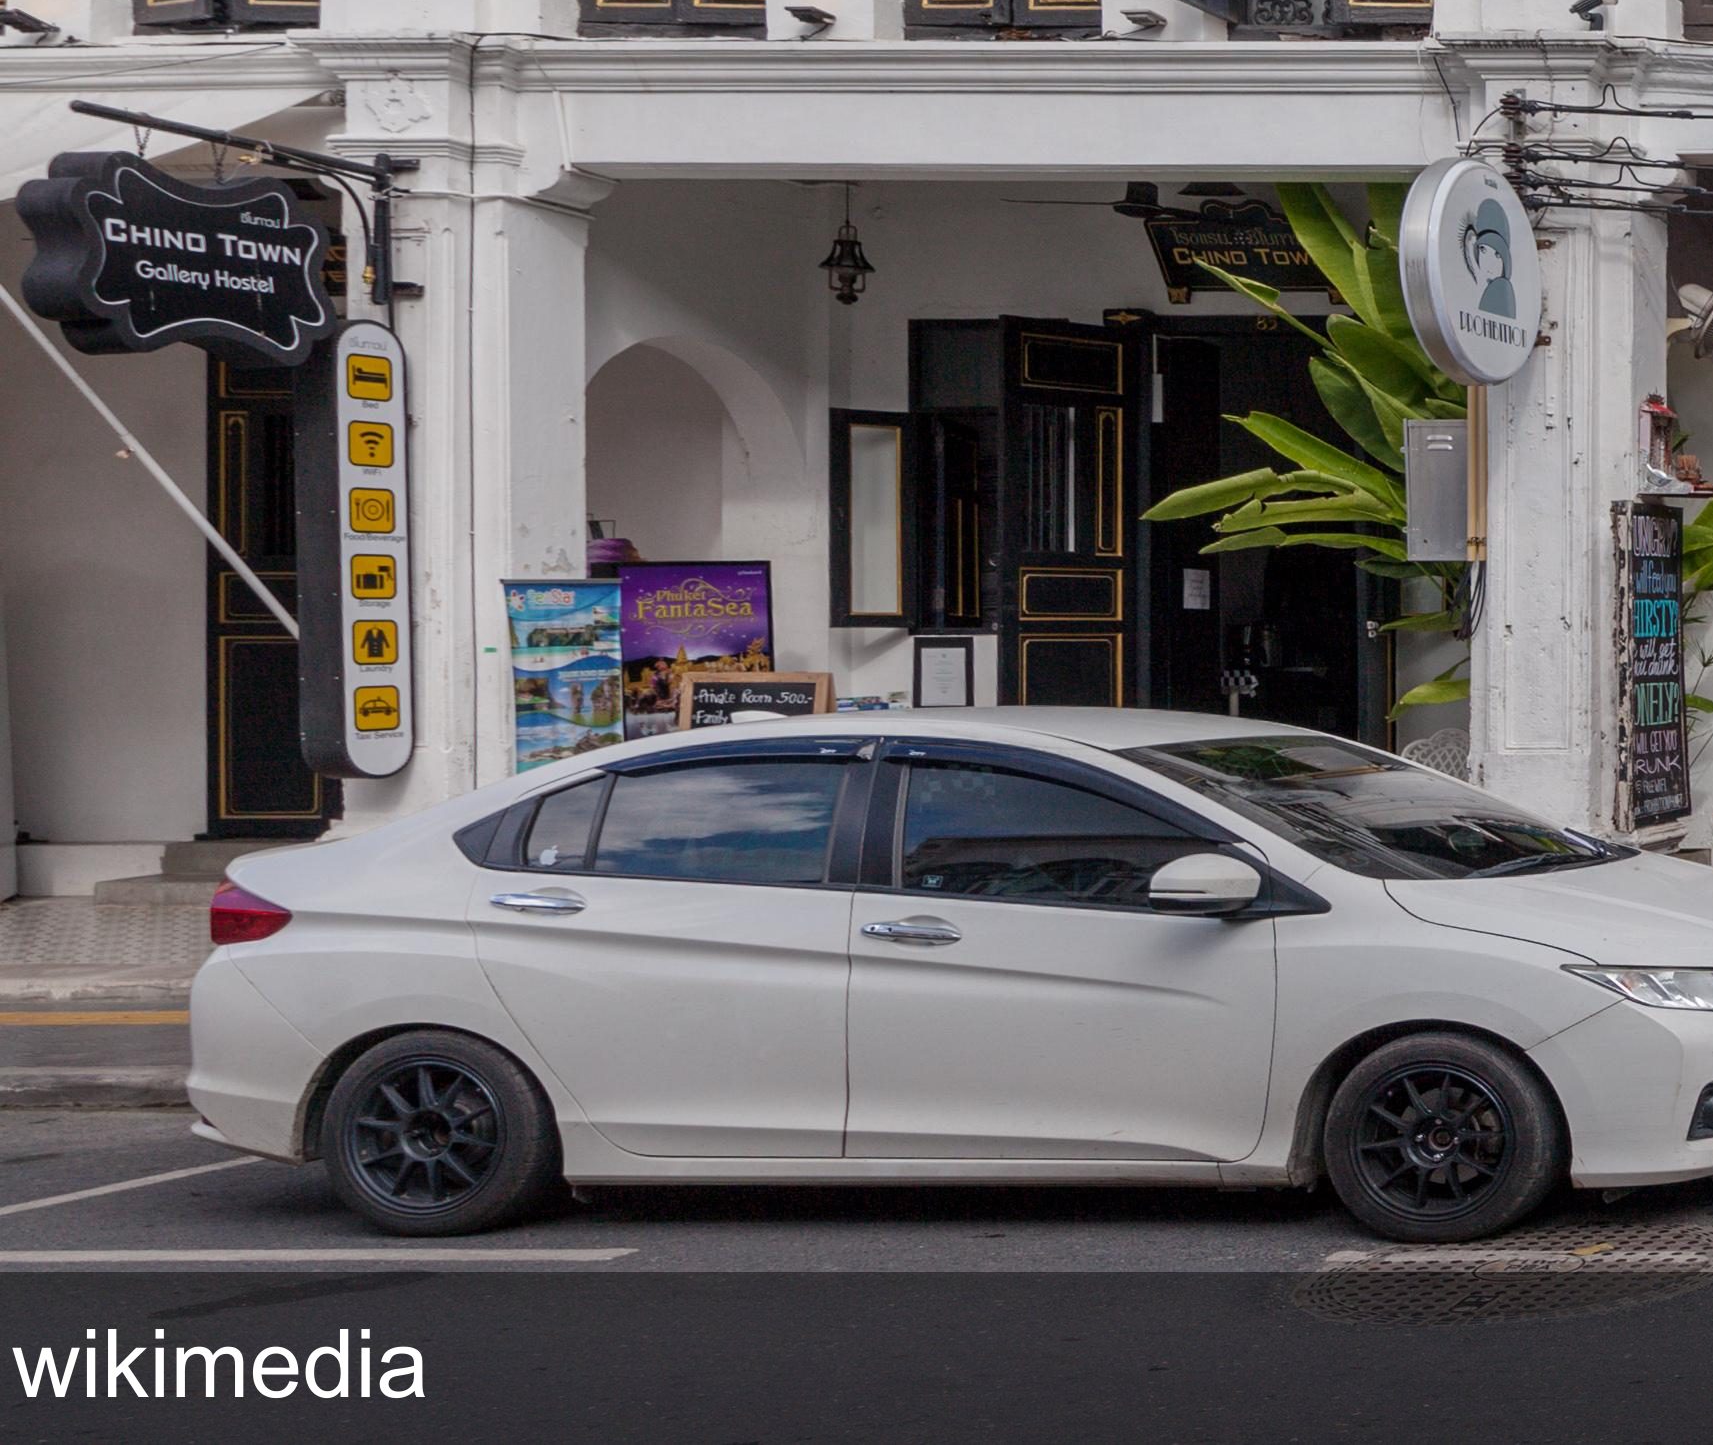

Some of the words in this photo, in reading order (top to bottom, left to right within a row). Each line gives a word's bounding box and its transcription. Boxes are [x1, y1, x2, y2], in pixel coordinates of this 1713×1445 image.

[104, 217, 207, 253] CHINO
[217, 233, 301, 266] TOWN
[1253, 248, 1311, 266] TOW
[135, 260, 210, 291] Gallery
[215, 269, 275, 294] Hostel
[1459, 310, 1527, 348] PROHIBITION
[362, 399, 380, 409] Bed
[363, 467, 382, 476] WiFi
[344, 531, 406, 544] Food/Beverage
[1632, 515, 1678, 557] UNGRY?
[655, 588, 707, 602] Phuket
[359, 599, 392, 609] Storage
[636, 597, 753, 619] FantaSea
[1633, 598, 1679, 638] HIRSTY?
[359, 665, 393, 674] Laundry
[698, 689, 736, 705] Private
[741, 689, 772, 704] Room
[1633, 681, 1681, 727] ONELY?
[695, 710, 729, 725] Family
[355, 732, 371, 741] Taxi
[374, 730, 404, 741] Service
[1634, 755, 1682, 775] RUNK
